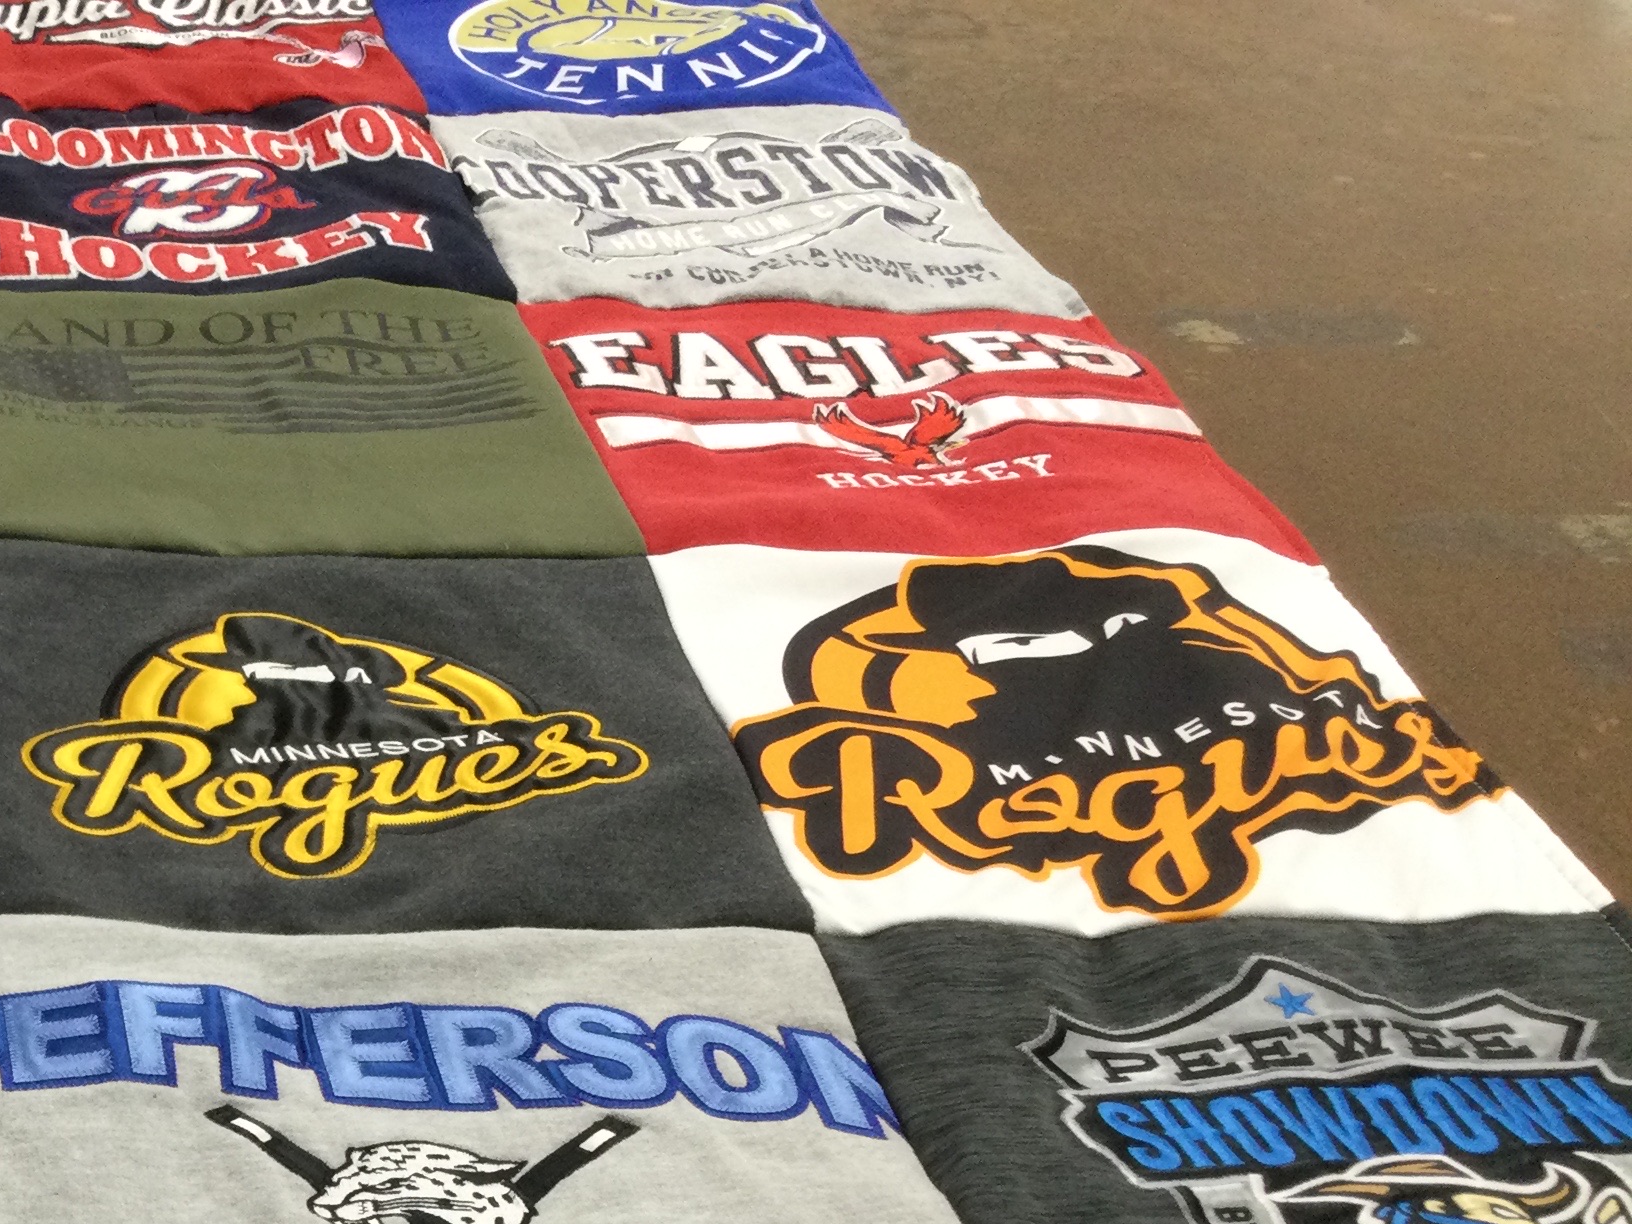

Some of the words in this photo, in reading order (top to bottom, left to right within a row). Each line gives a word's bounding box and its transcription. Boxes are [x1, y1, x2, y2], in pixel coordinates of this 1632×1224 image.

[609, 226, 711, 252] HOME
[721, 213, 794, 240] RUN
[198, 310, 300, 346] OF
[319, 309, 483, 343] THE
[548, 329, 1148, 400] EAGLES
[815, 453, 1055, 490] HOCKEY
[230, 729, 505, 765] MINNESOTA
[988, 690, 1383, 788] MINNESOTA
[53, 723, 615, 864] Rogues
[760, 709, 1483, 904] Rogues
[1085, 1017, 1536, 1084] PEEWEE
[1096, 1073, 1632, 1172] SHOWDOWN
